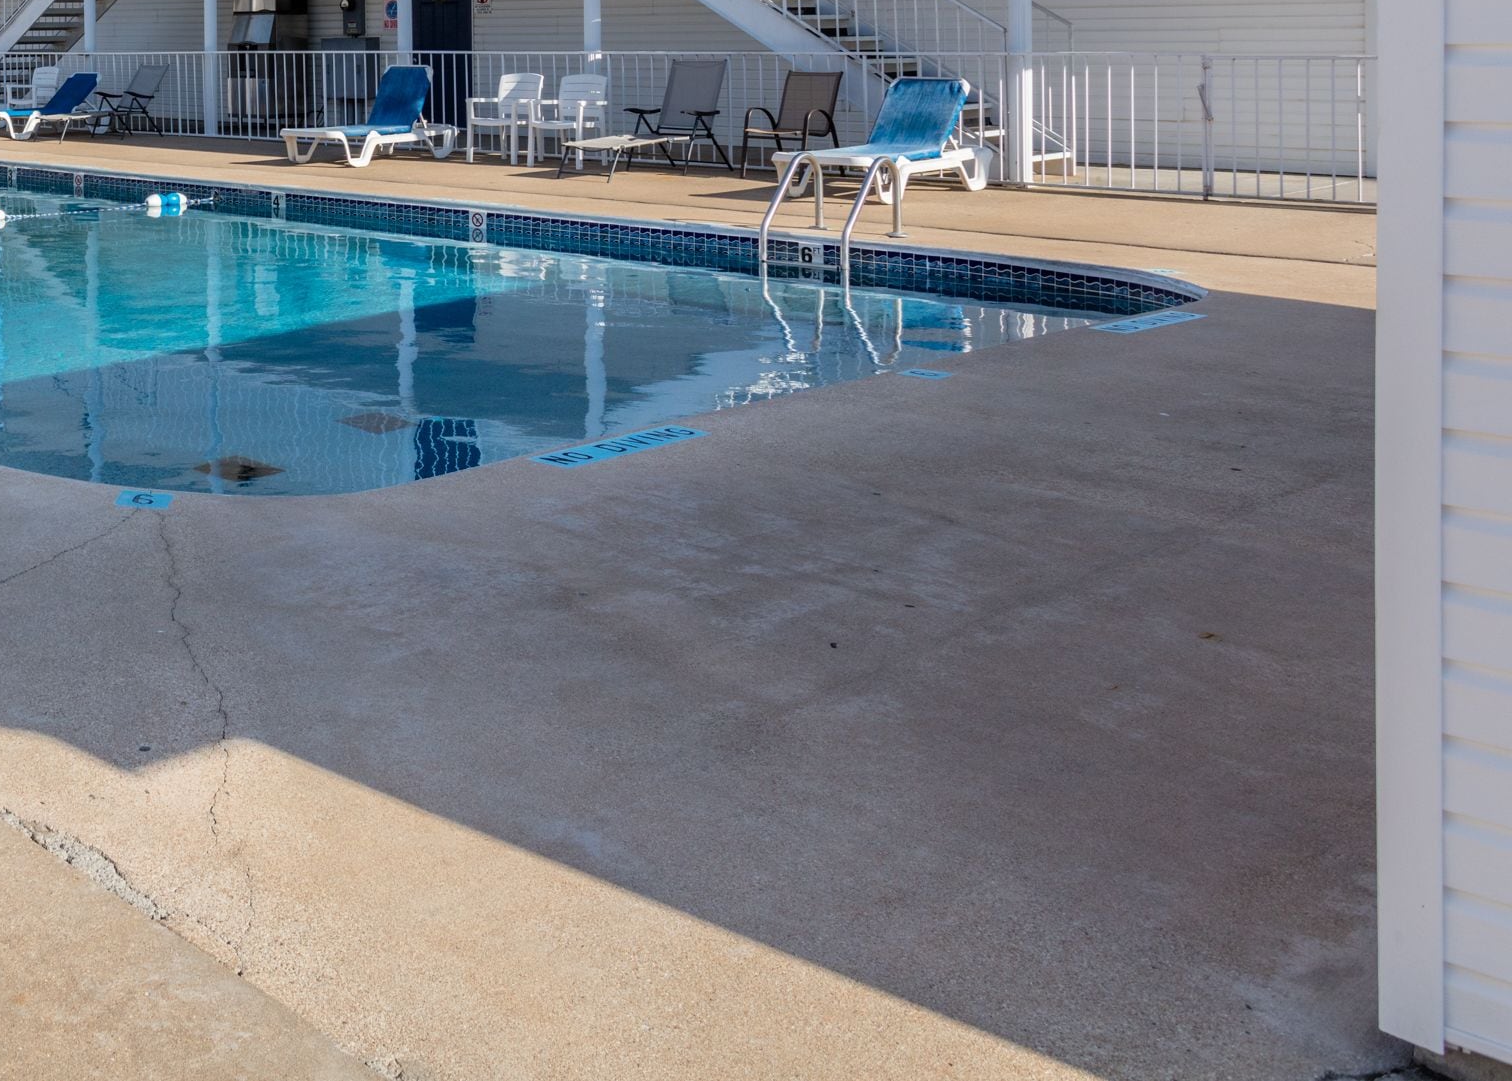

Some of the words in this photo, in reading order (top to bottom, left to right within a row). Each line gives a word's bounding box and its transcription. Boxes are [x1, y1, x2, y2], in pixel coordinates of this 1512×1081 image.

[273, 195, 280, 207] 4
[801, 246, 813, 263] 6
[812, 247, 822, 255] FT
[539, 451, 594, 465] NO
[593, 427, 696, 453] DIVING
[132, 493, 154, 505] 6
